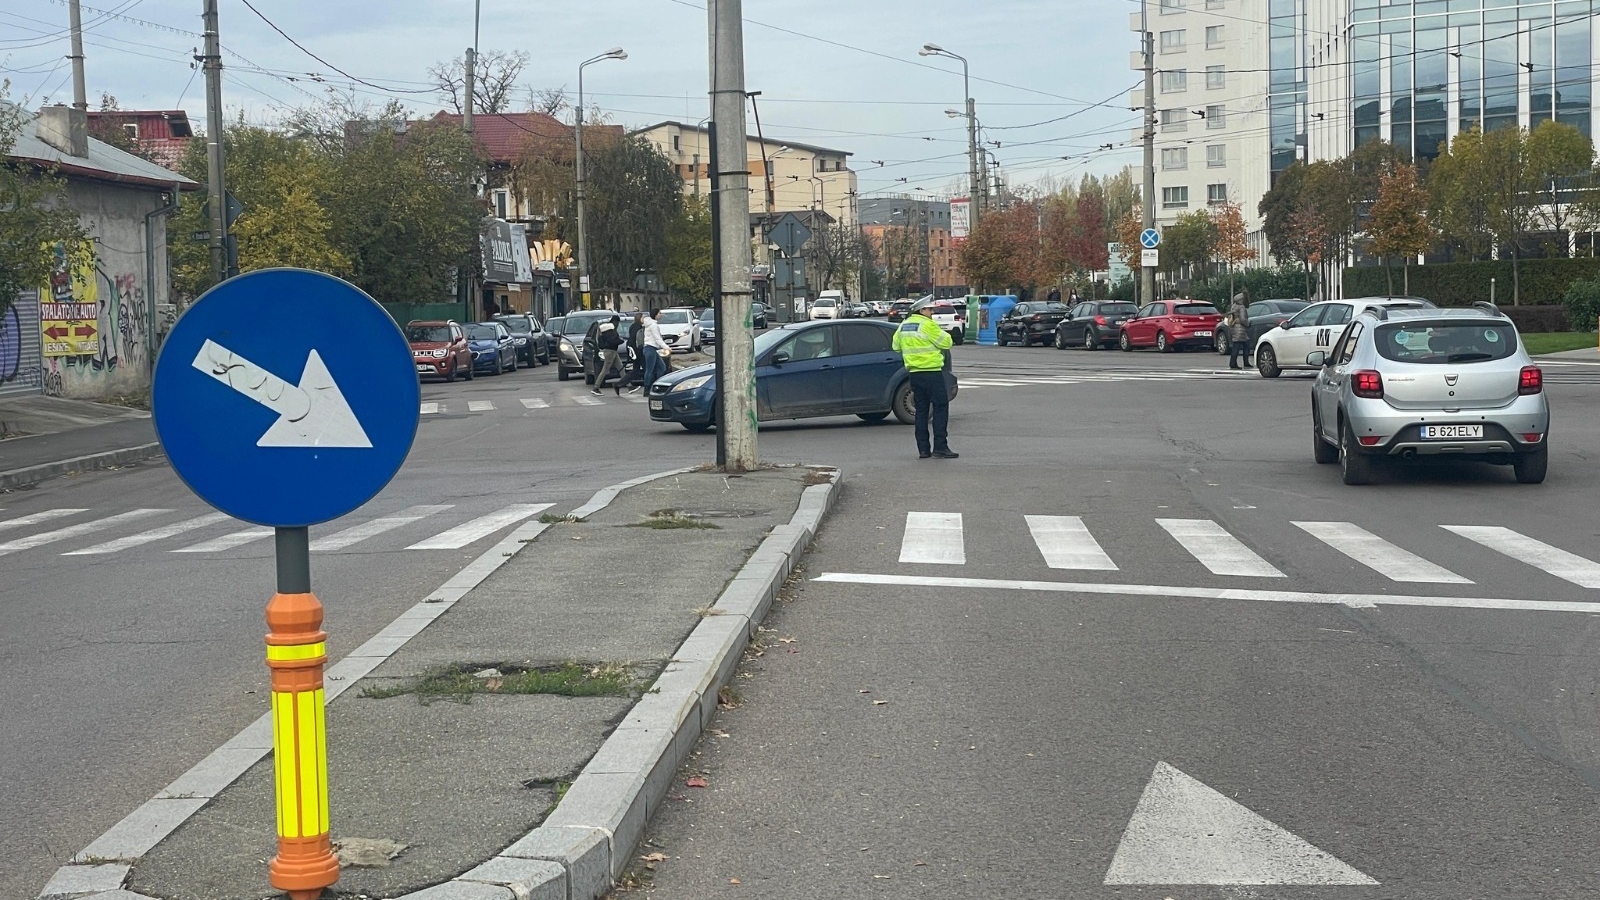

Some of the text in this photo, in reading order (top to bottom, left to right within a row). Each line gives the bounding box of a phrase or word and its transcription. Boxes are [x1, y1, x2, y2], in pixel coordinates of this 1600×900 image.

[491, 239, 512, 262] PADRE
[80, 303, 97, 319] AUTO
[44, 342, 69, 353] IESIRE
[1428, 426, 1479, 437] B 621ELY
